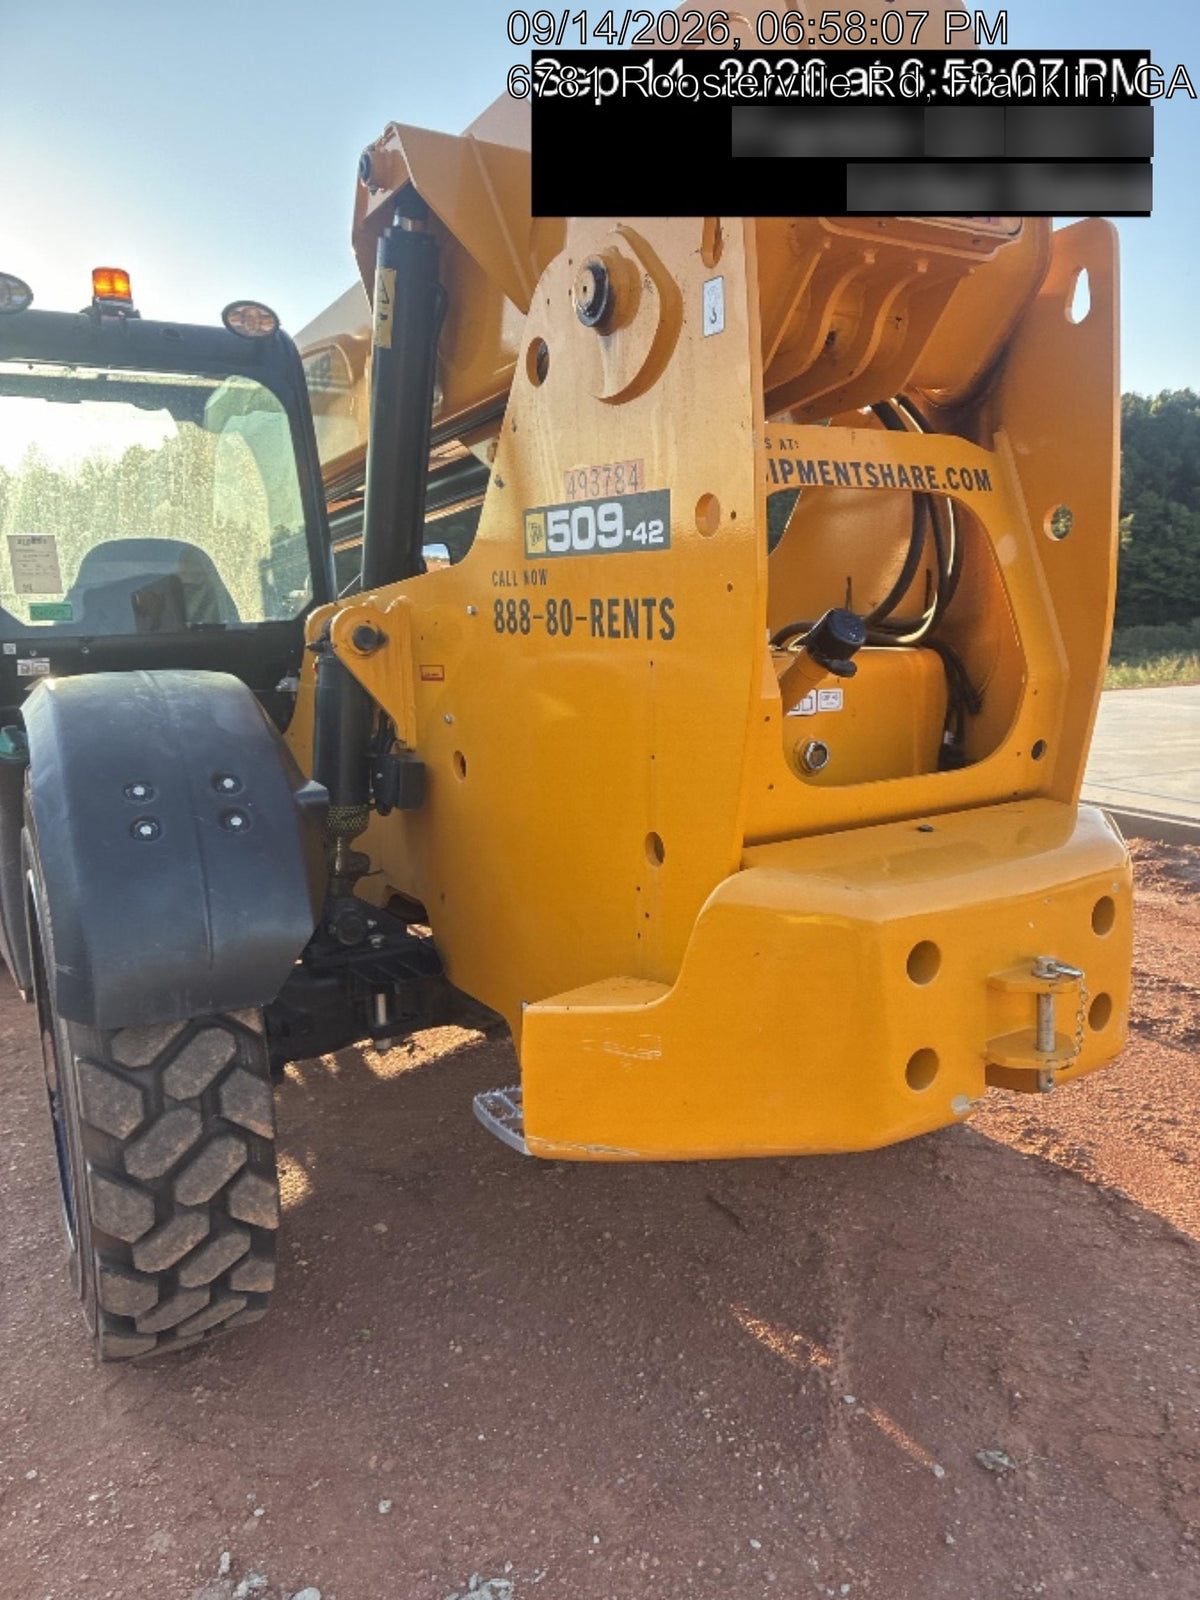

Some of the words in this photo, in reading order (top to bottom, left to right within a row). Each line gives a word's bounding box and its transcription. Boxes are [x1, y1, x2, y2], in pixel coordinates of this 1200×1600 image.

[567, 464, 639, 500] 493784
[765, 458, 993, 492] IPMENTSHARE.COM
[491, 571, 519, 588] CALL
[523, 568, 548, 586] NOW
[493, 597, 676, 641] 888-80-RENTS
